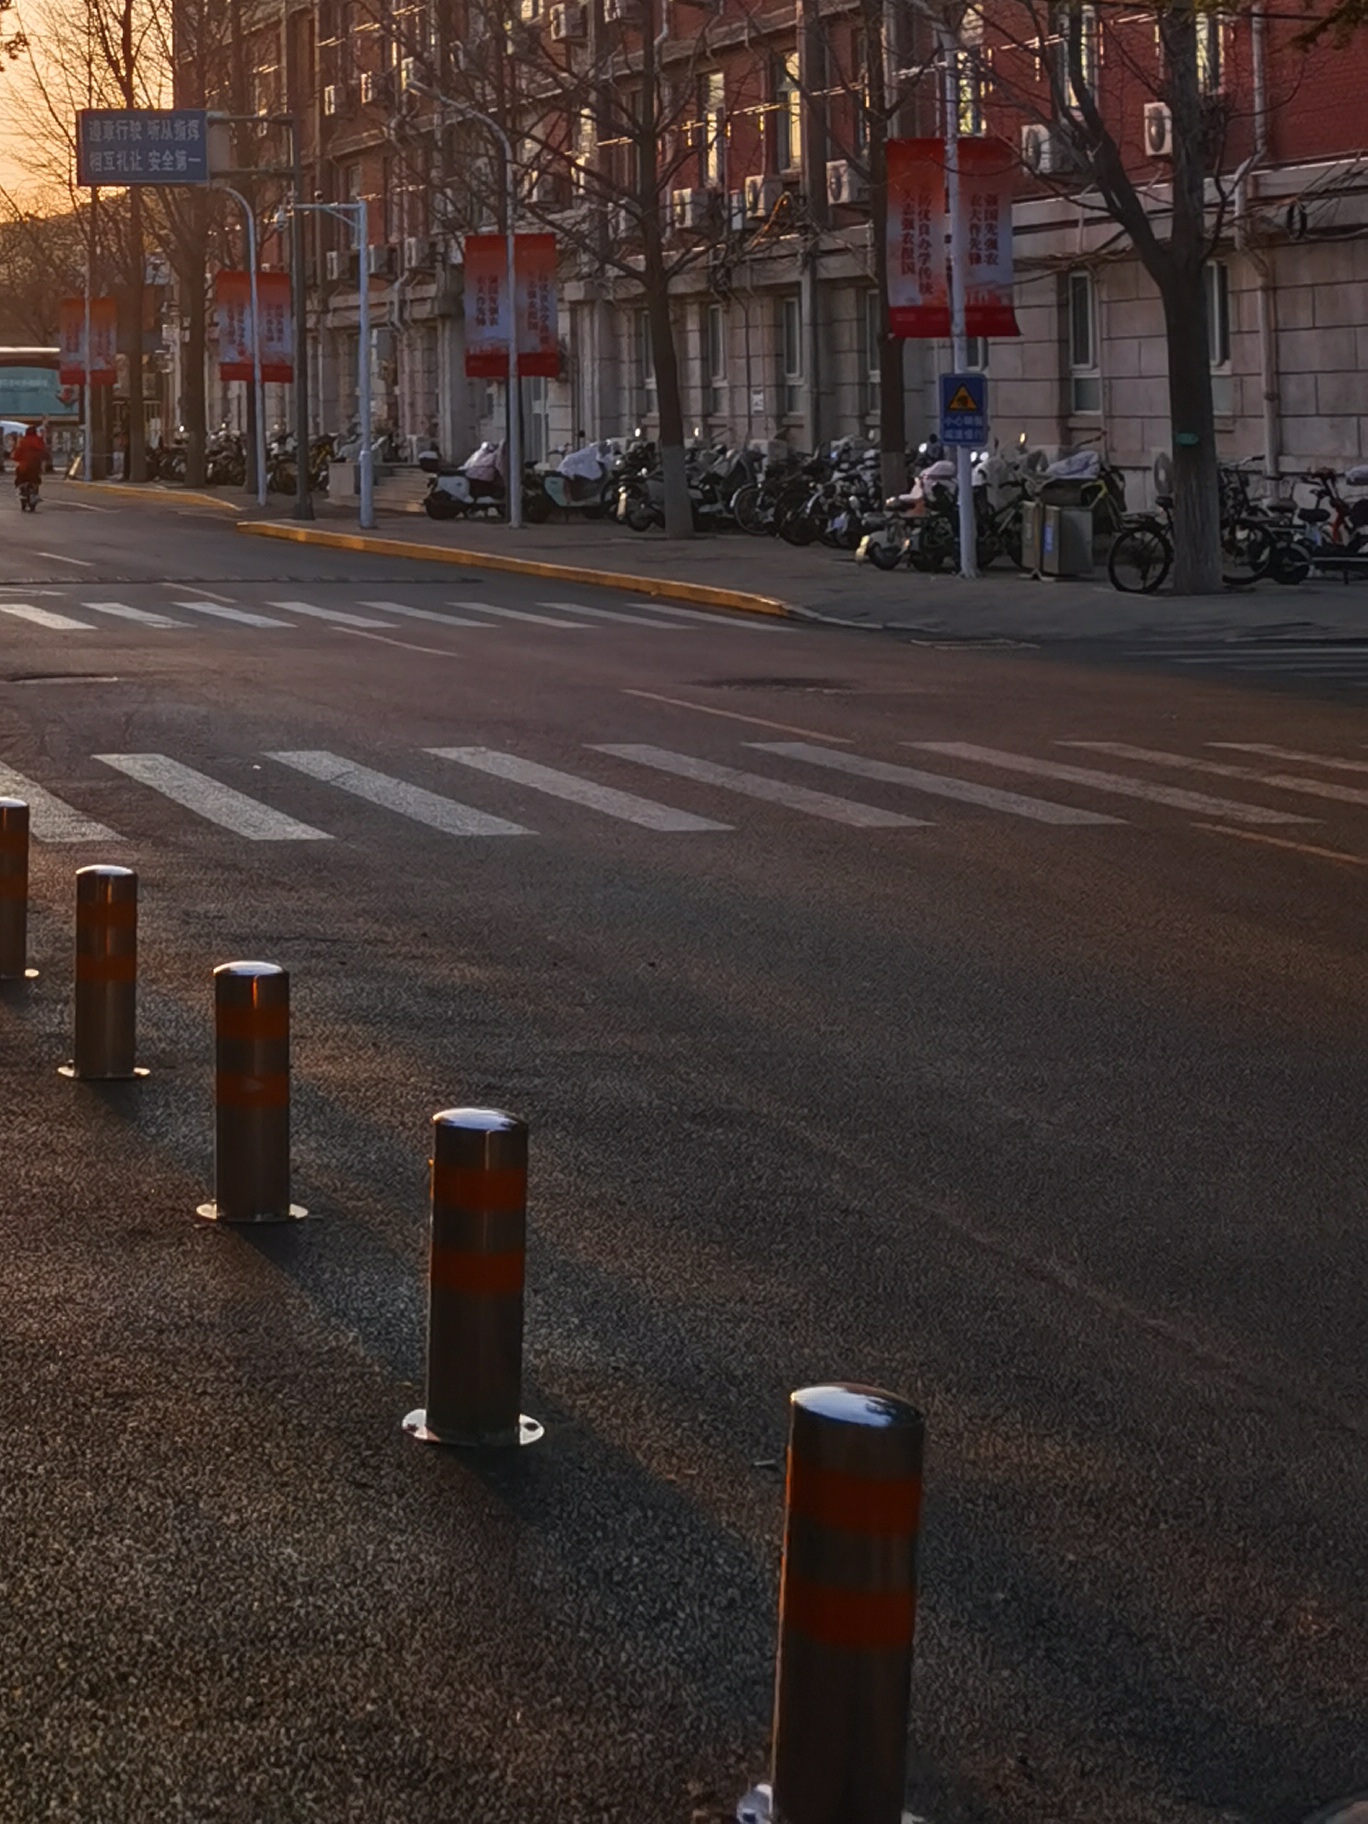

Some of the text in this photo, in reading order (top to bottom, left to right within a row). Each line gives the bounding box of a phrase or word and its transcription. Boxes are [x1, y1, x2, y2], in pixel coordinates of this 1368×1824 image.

[89, 149, 202, 172] 相互礼让 安全第一
